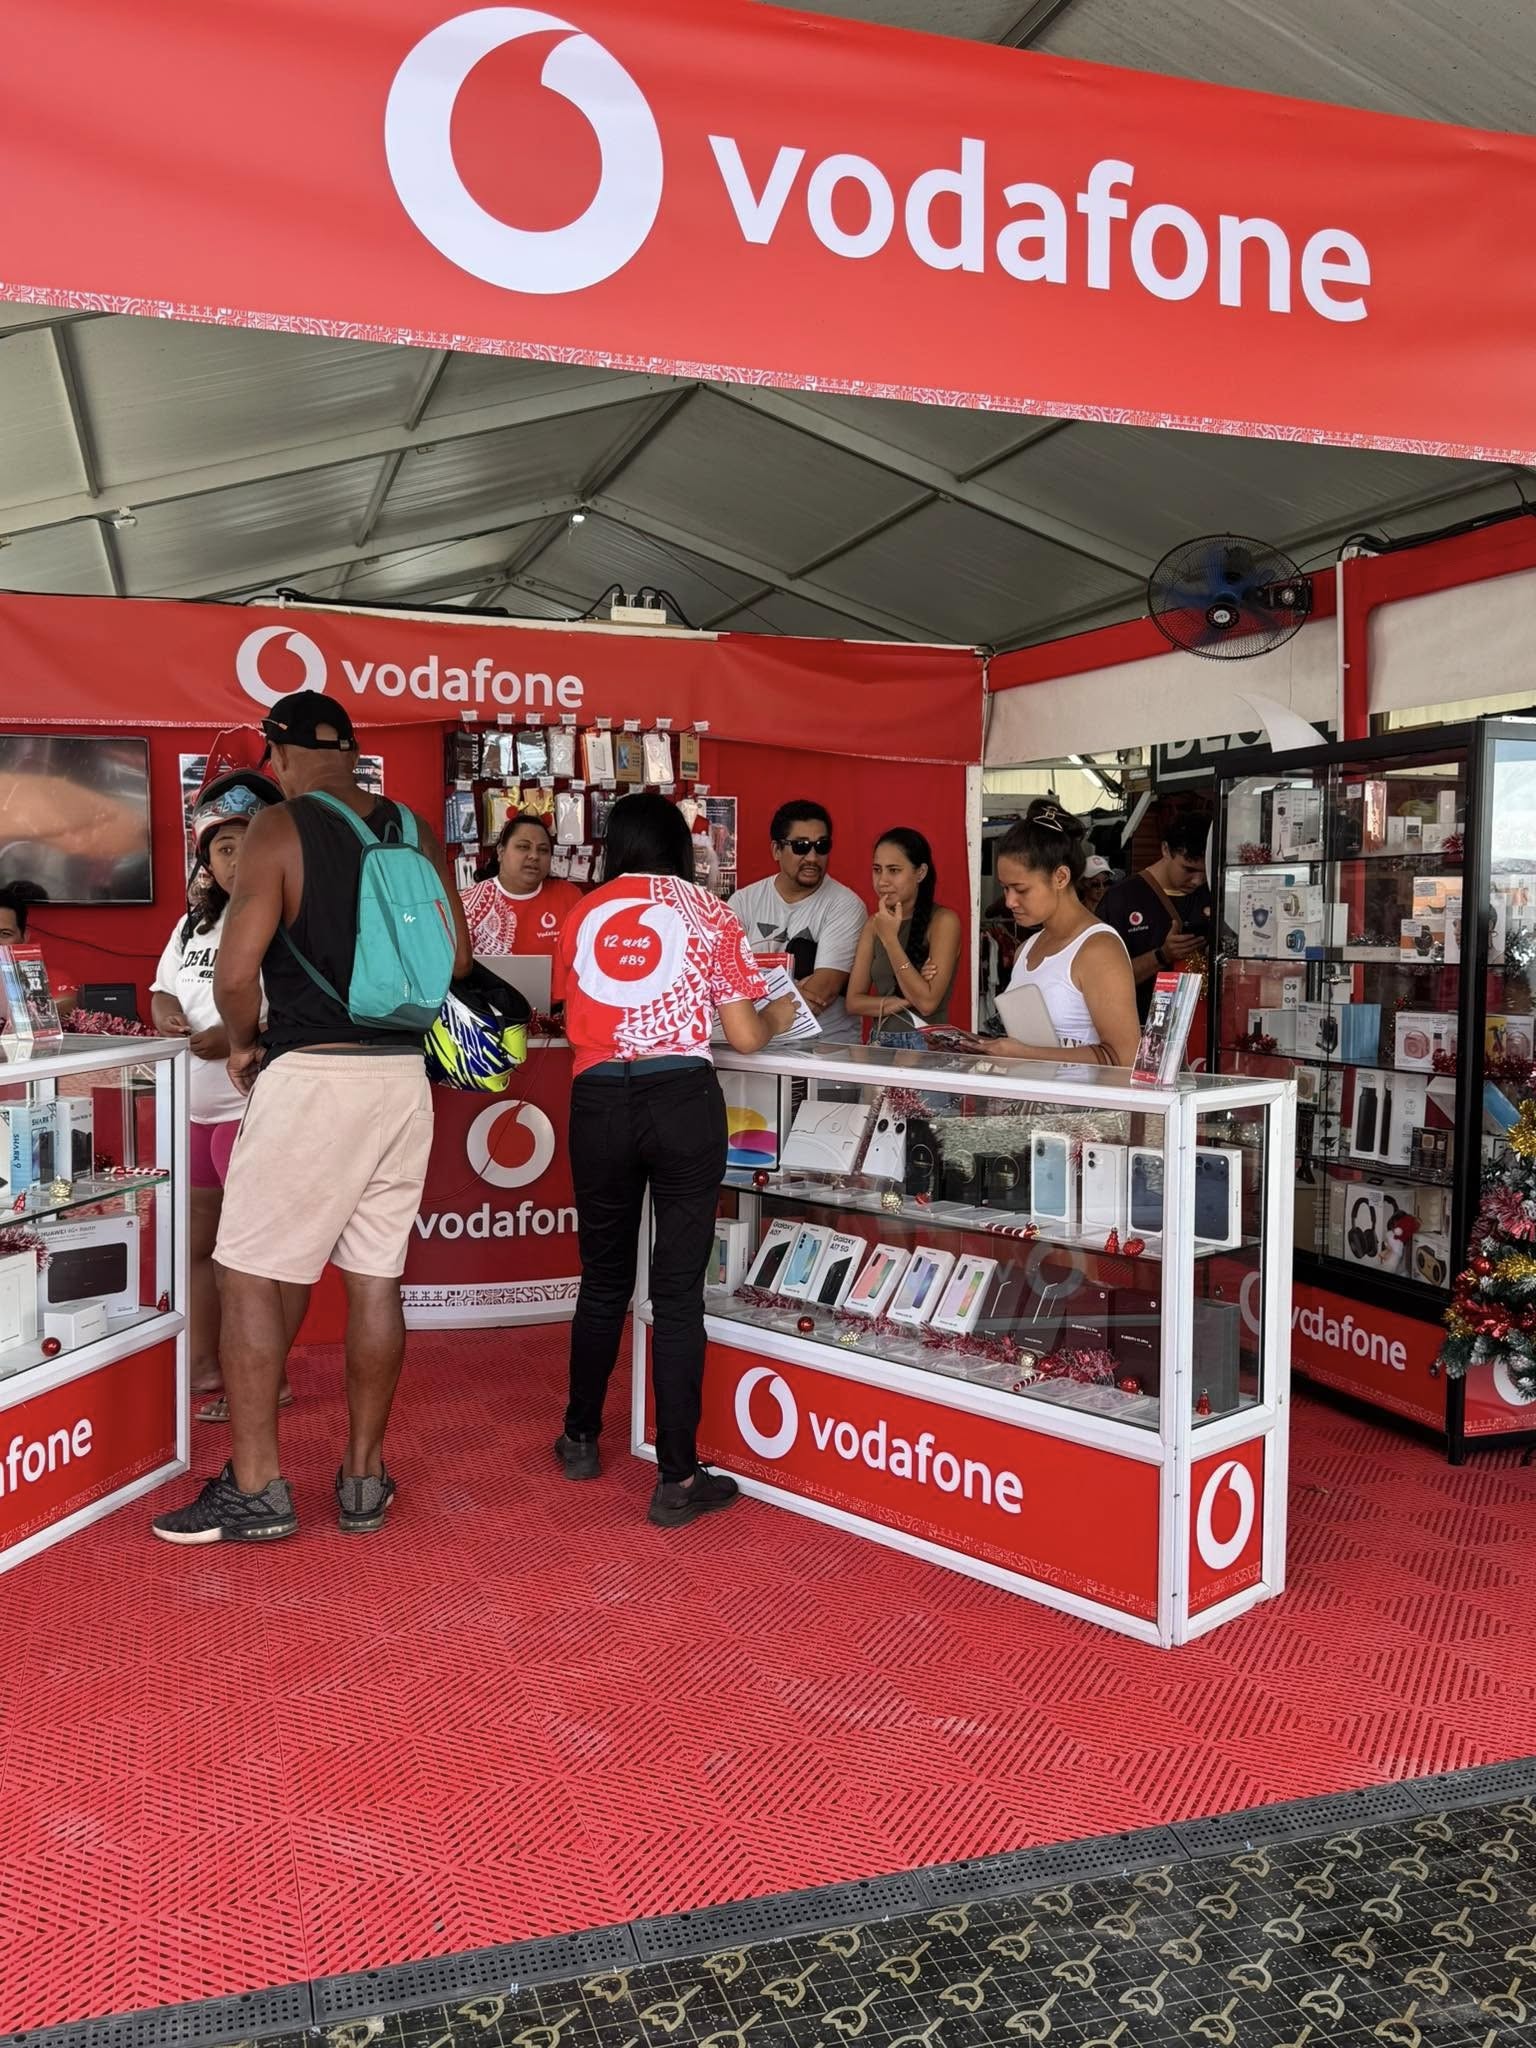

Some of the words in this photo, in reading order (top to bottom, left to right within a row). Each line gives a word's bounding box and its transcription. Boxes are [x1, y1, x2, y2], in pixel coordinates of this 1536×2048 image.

[708, 135, 1371, 322] vodafone
[341, 654, 585, 709] vodafone
[604, 934, 619, 948] 12
[622, 935, 651, 949] ans
[620, 955, 646, 966] #89
[772, 1220, 795, 1231] Galaxy
[833, 1234, 856, 1246] Galaxy
[0, 1418, 93, 1498] fone
[810, 1411, 1023, 1515] vodafone
